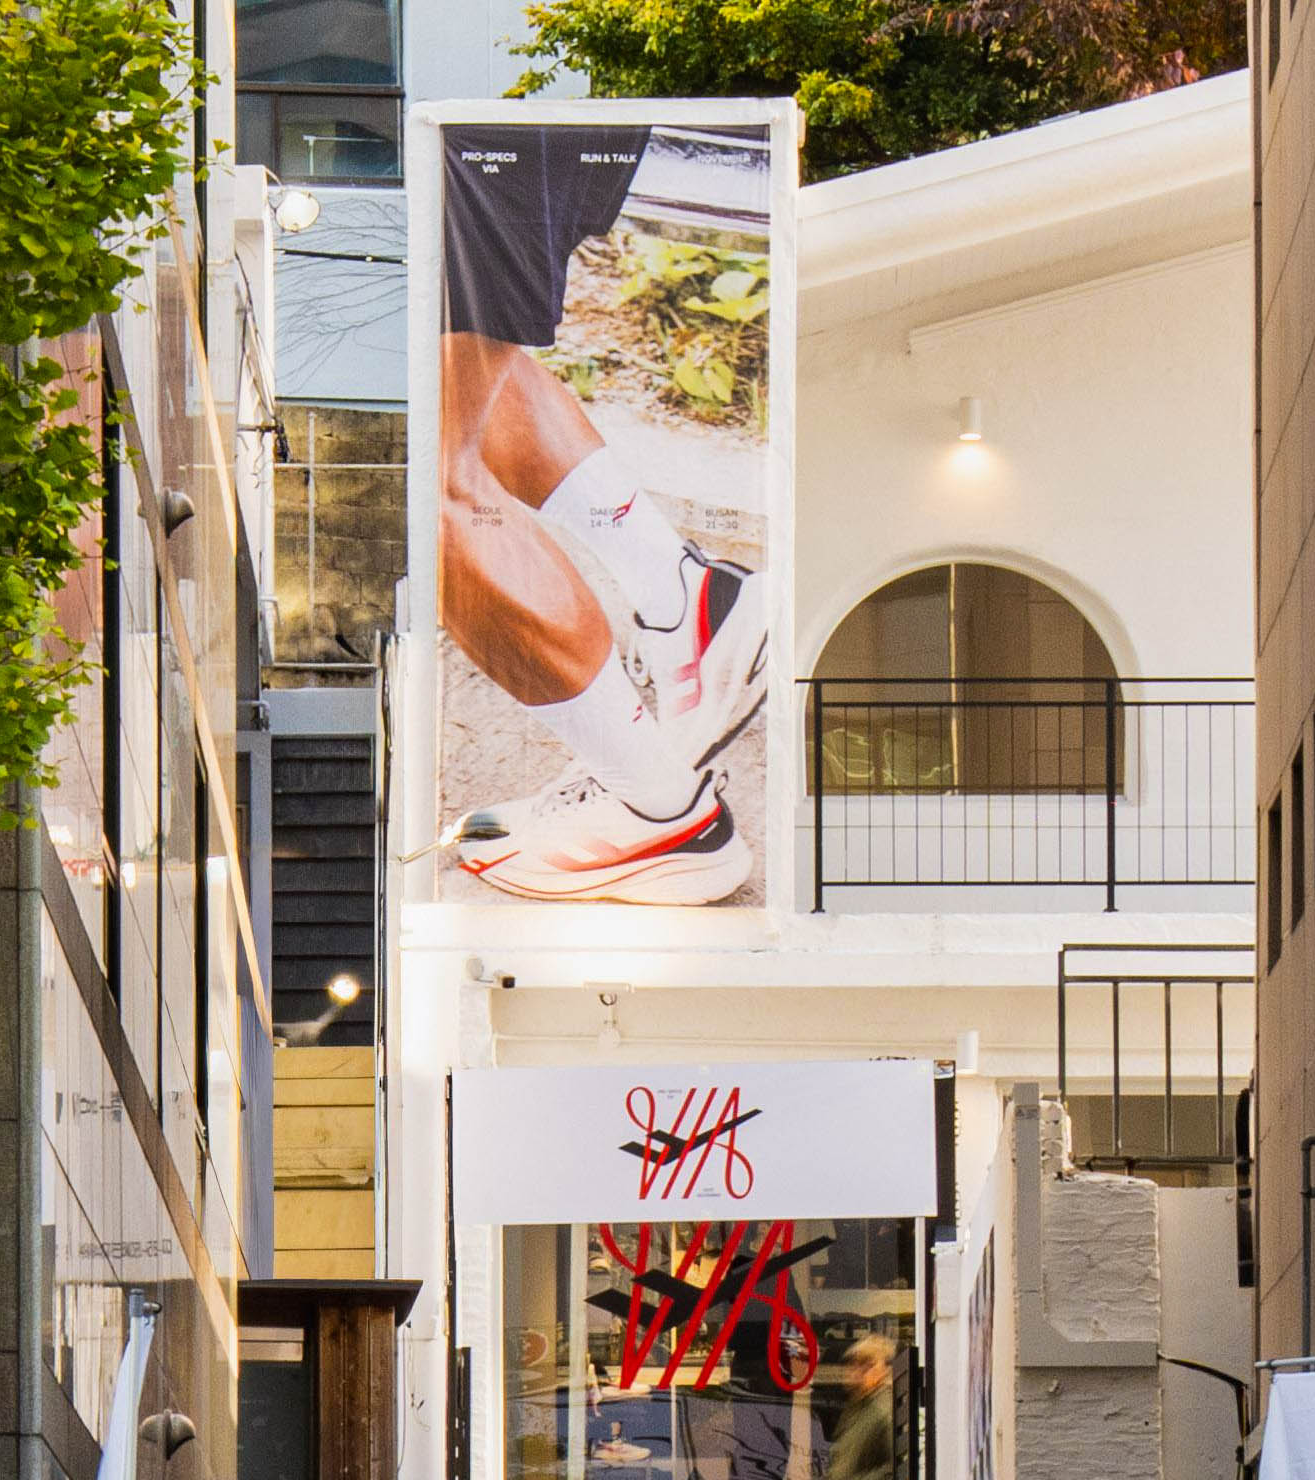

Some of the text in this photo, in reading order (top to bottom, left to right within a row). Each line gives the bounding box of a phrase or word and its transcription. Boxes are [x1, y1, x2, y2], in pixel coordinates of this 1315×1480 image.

[461, 151, 517, 163] PRO-SPECS
[580, 152, 638, 164] RUN & TALK
[482, 163, 500, 174] VIA
[472, 506, 502, 516] SEOUL
[705, 508, 739, 518] BUSAN
